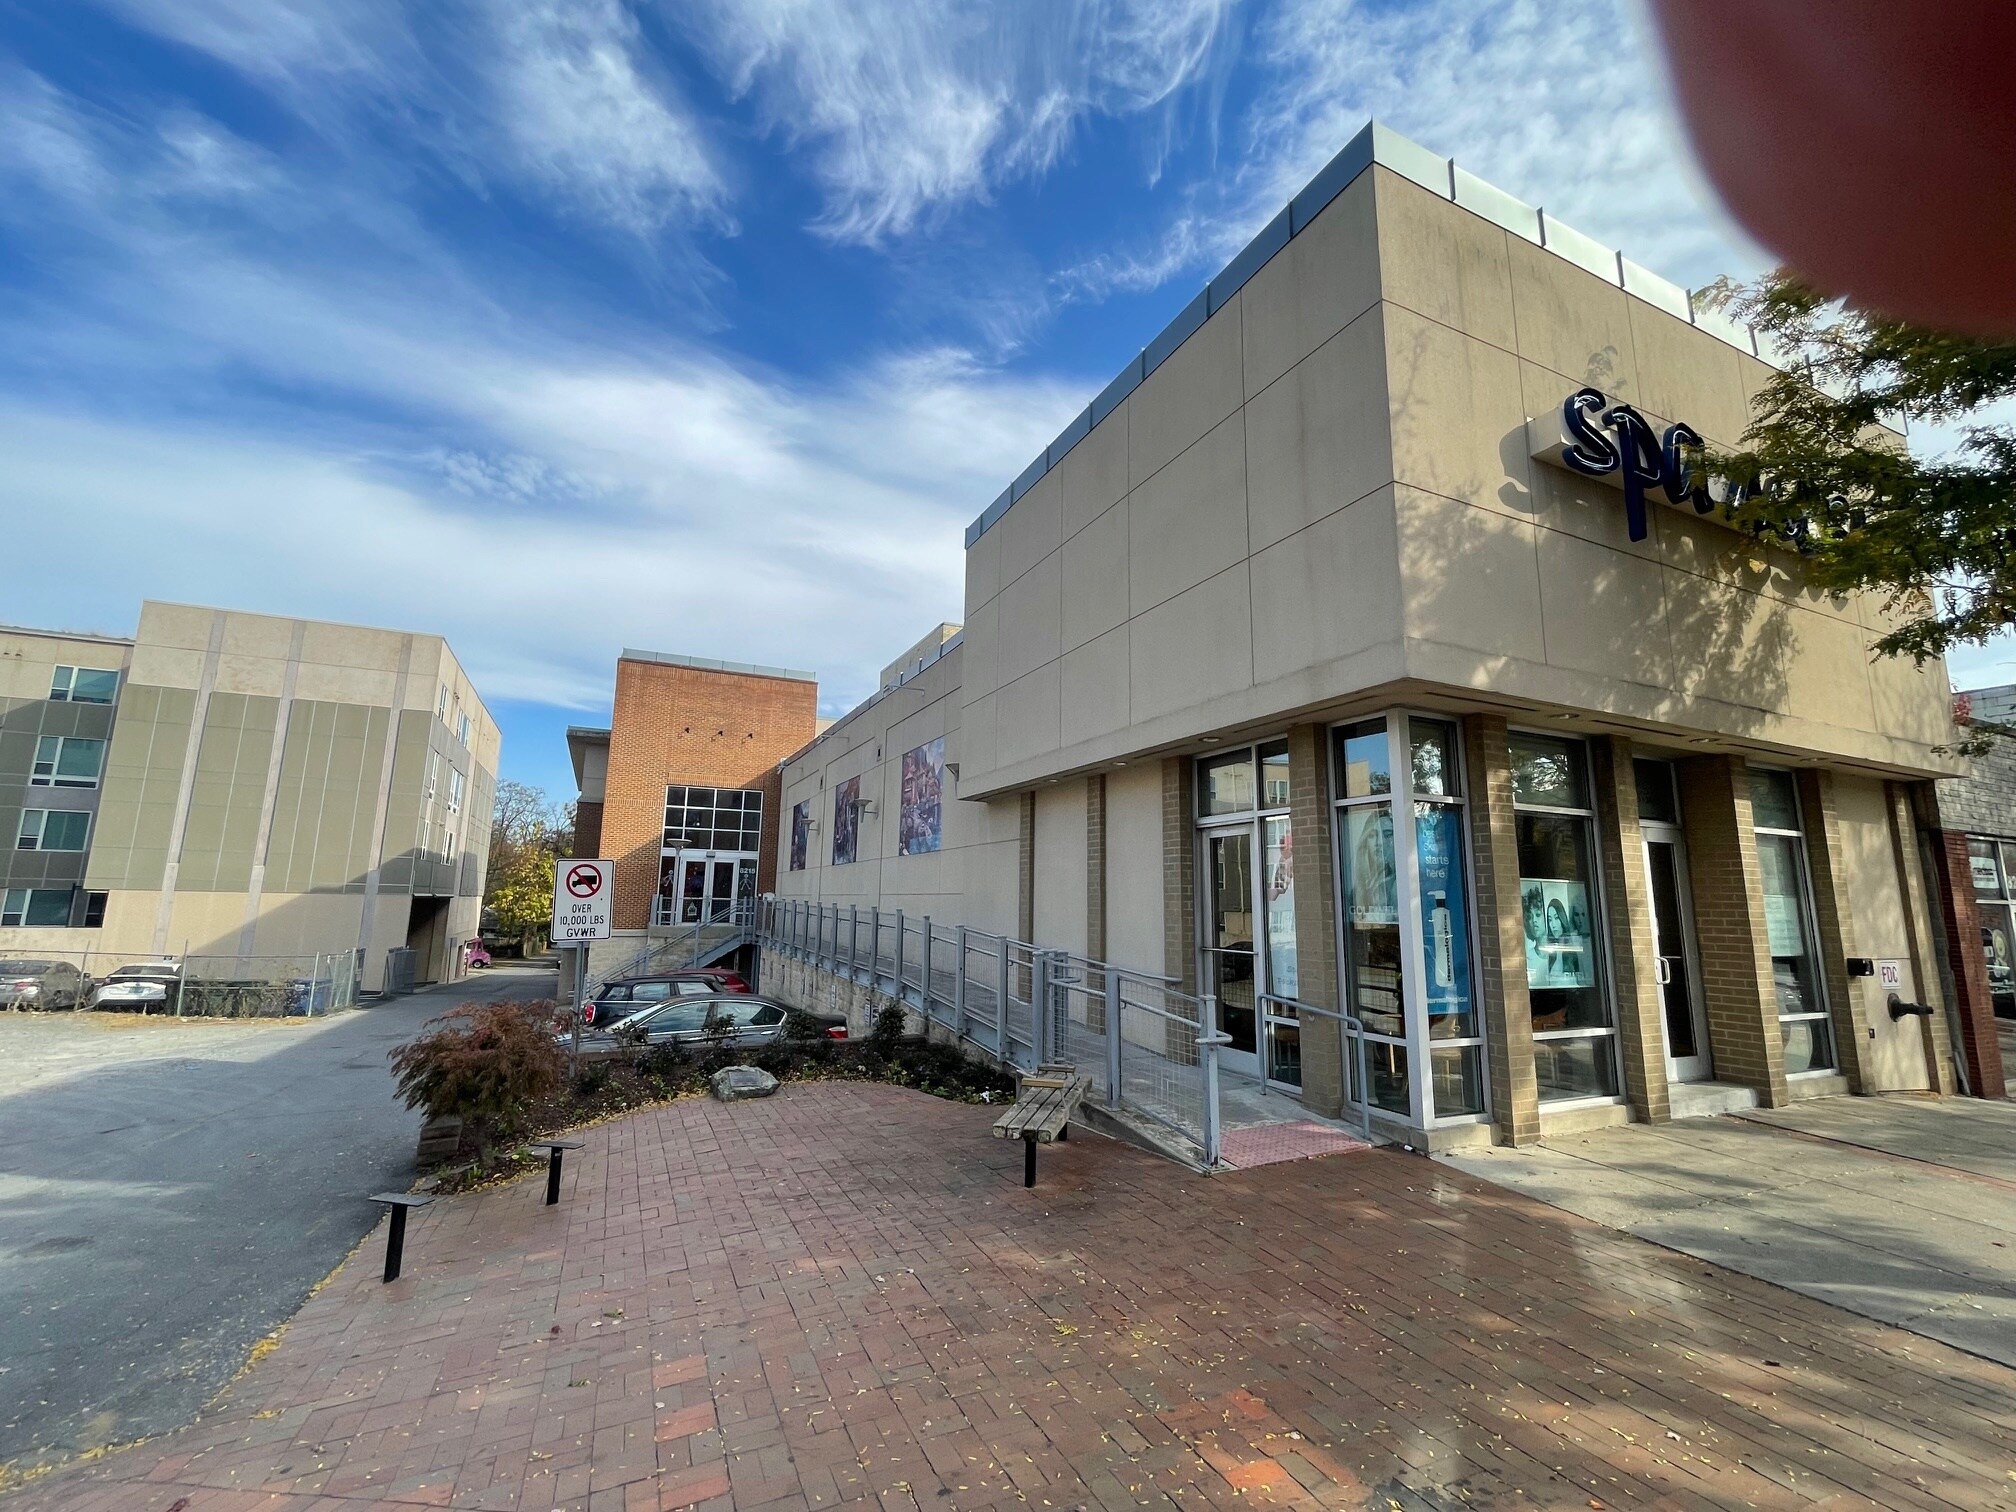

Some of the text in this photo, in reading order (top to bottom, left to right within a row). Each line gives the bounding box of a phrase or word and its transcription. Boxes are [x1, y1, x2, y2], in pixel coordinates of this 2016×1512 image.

[1425, 855, 1450, 865] starts
[1426, 867, 1446, 878] here
[571, 903, 592, 914] OVER
[560, 915, 605, 927] 10,000 LBS
[566, 927, 596, 938] GVWR
[1881, 966, 1899, 984] FDC
